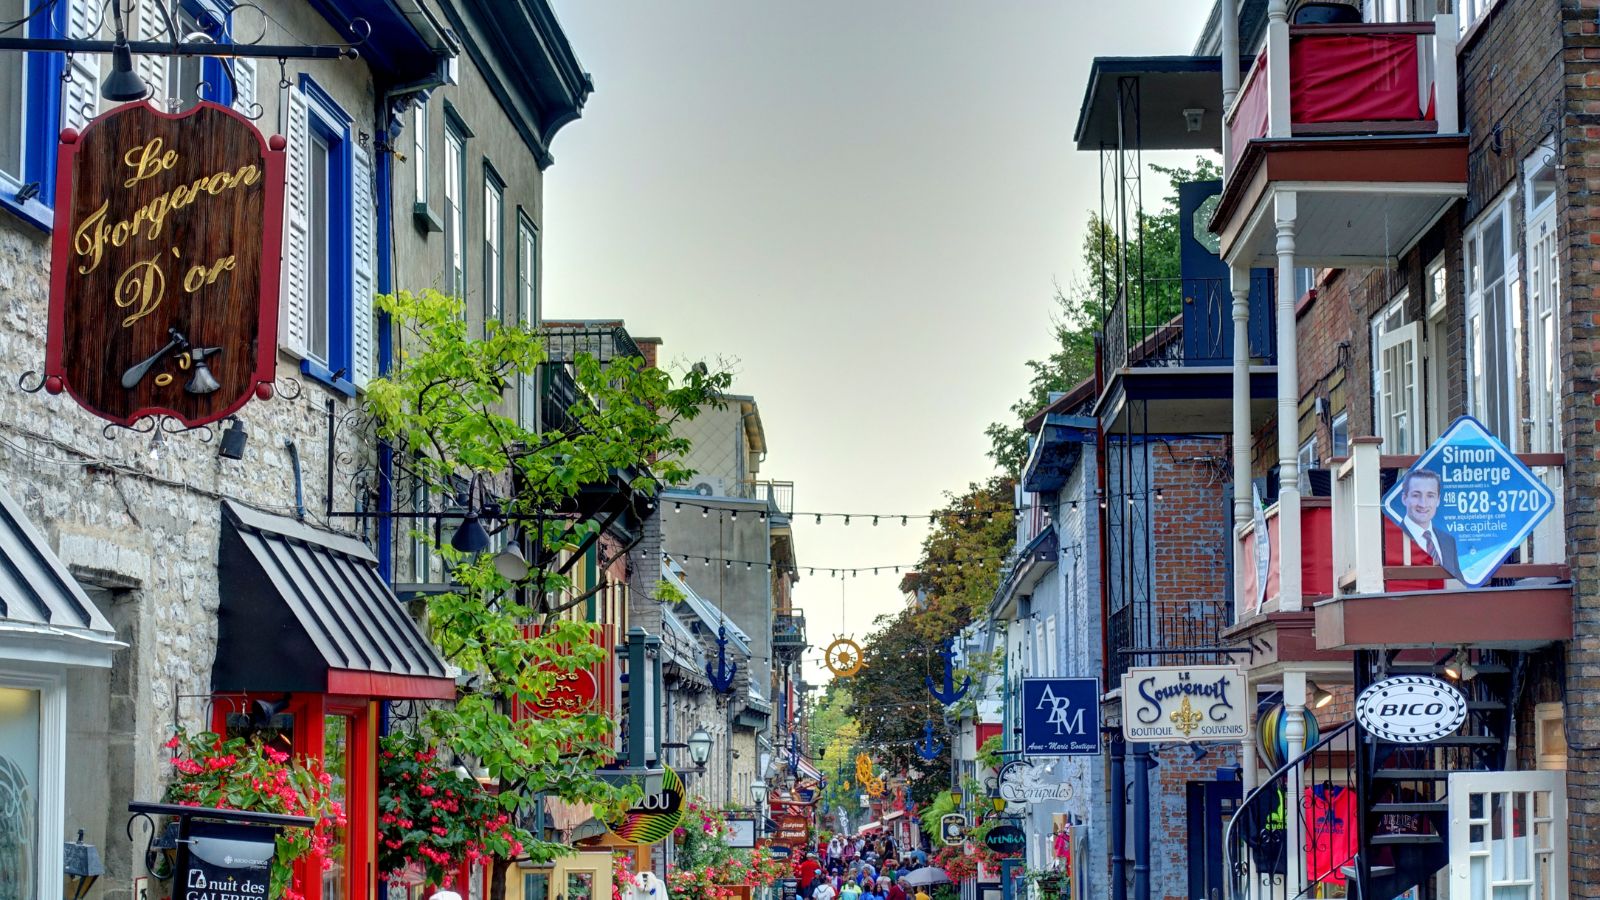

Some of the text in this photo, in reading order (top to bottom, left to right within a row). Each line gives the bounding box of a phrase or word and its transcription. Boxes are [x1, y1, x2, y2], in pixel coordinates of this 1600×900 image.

[124, 136, 178, 189] Le
[75, 163, 262, 275] Forgeron
[1442, 446, 1495, 463] Simon
[1442, 464, 1511, 486] Laberge
[1444, 489, 1540, 514] 418 628-3720
[1178, 671, 1190, 680] LE
[1379, 703, 1444, 717] BICO
[1131, 725, 1244, 737] BOUTIQUE SOUVENIRS
[1070, 741, 1096, 752] Boutique
[1002, 784, 1071, 800] Scrupules
[630, 793, 669, 810] ZOU
[208, 879, 238, 891] nuit
[240, 880, 265, 893] des
